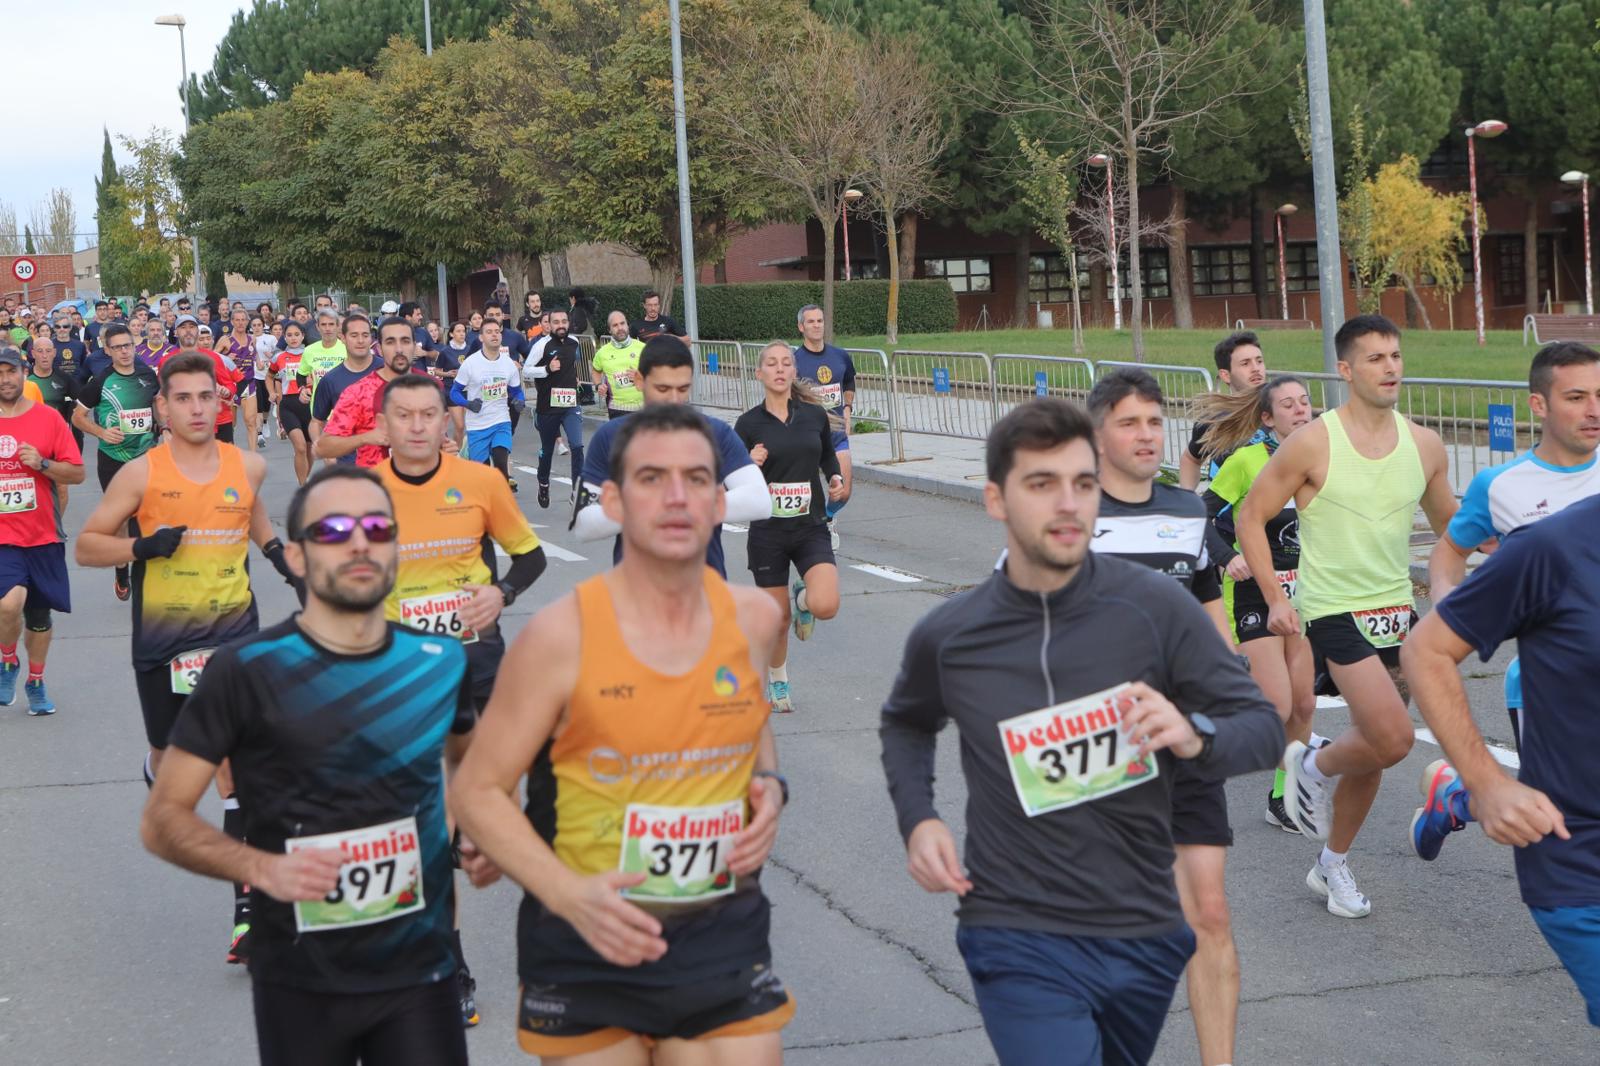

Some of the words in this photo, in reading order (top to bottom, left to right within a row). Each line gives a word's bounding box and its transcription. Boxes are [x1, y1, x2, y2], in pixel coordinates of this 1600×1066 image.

[18, 265, 32, 274] 30
[488, 388, 502, 396] 121
[556, 395, 572, 403] 112
[131, 418, 145, 429] 98
[3, 492, 22, 505] 73
[776, 496, 802, 509] 123
[417, 612, 462, 634] 266
[1367, 614, 1400, 636] 236
[1039, 729, 1118, 783] 377
[628, 810, 741, 839] bedunia
[649, 840, 719, 877] 371
